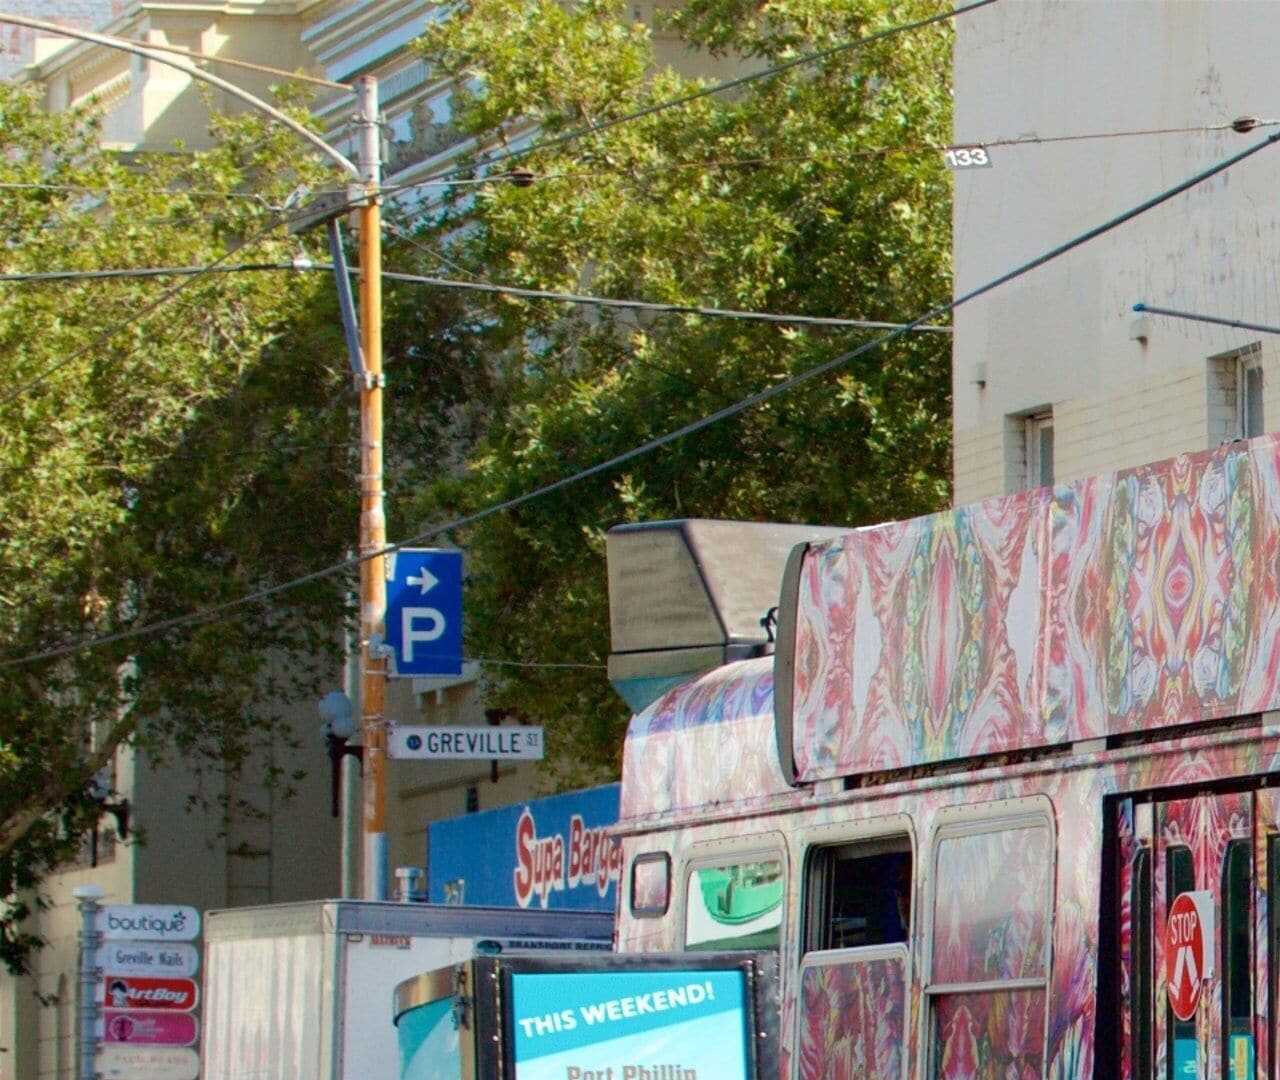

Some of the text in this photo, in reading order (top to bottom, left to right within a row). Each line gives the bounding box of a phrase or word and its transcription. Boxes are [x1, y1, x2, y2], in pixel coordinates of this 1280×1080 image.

[945, 148, 988, 166] 133
[402, 607, 446, 663] P
[428, 733, 538, 754] GREVILLE ST
[515, 807, 564, 908] Supa
[108, 913, 185, 936] boutique
[1170, 910, 1197, 945] STOP
[509, 940, 571, 950] TRANSPORT
[116, 950, 184, 966] Greville Nails
[129, 988, 189, 1004] ArtBoy
[519, 981, 715, 1038] THIS WEEKEND!
